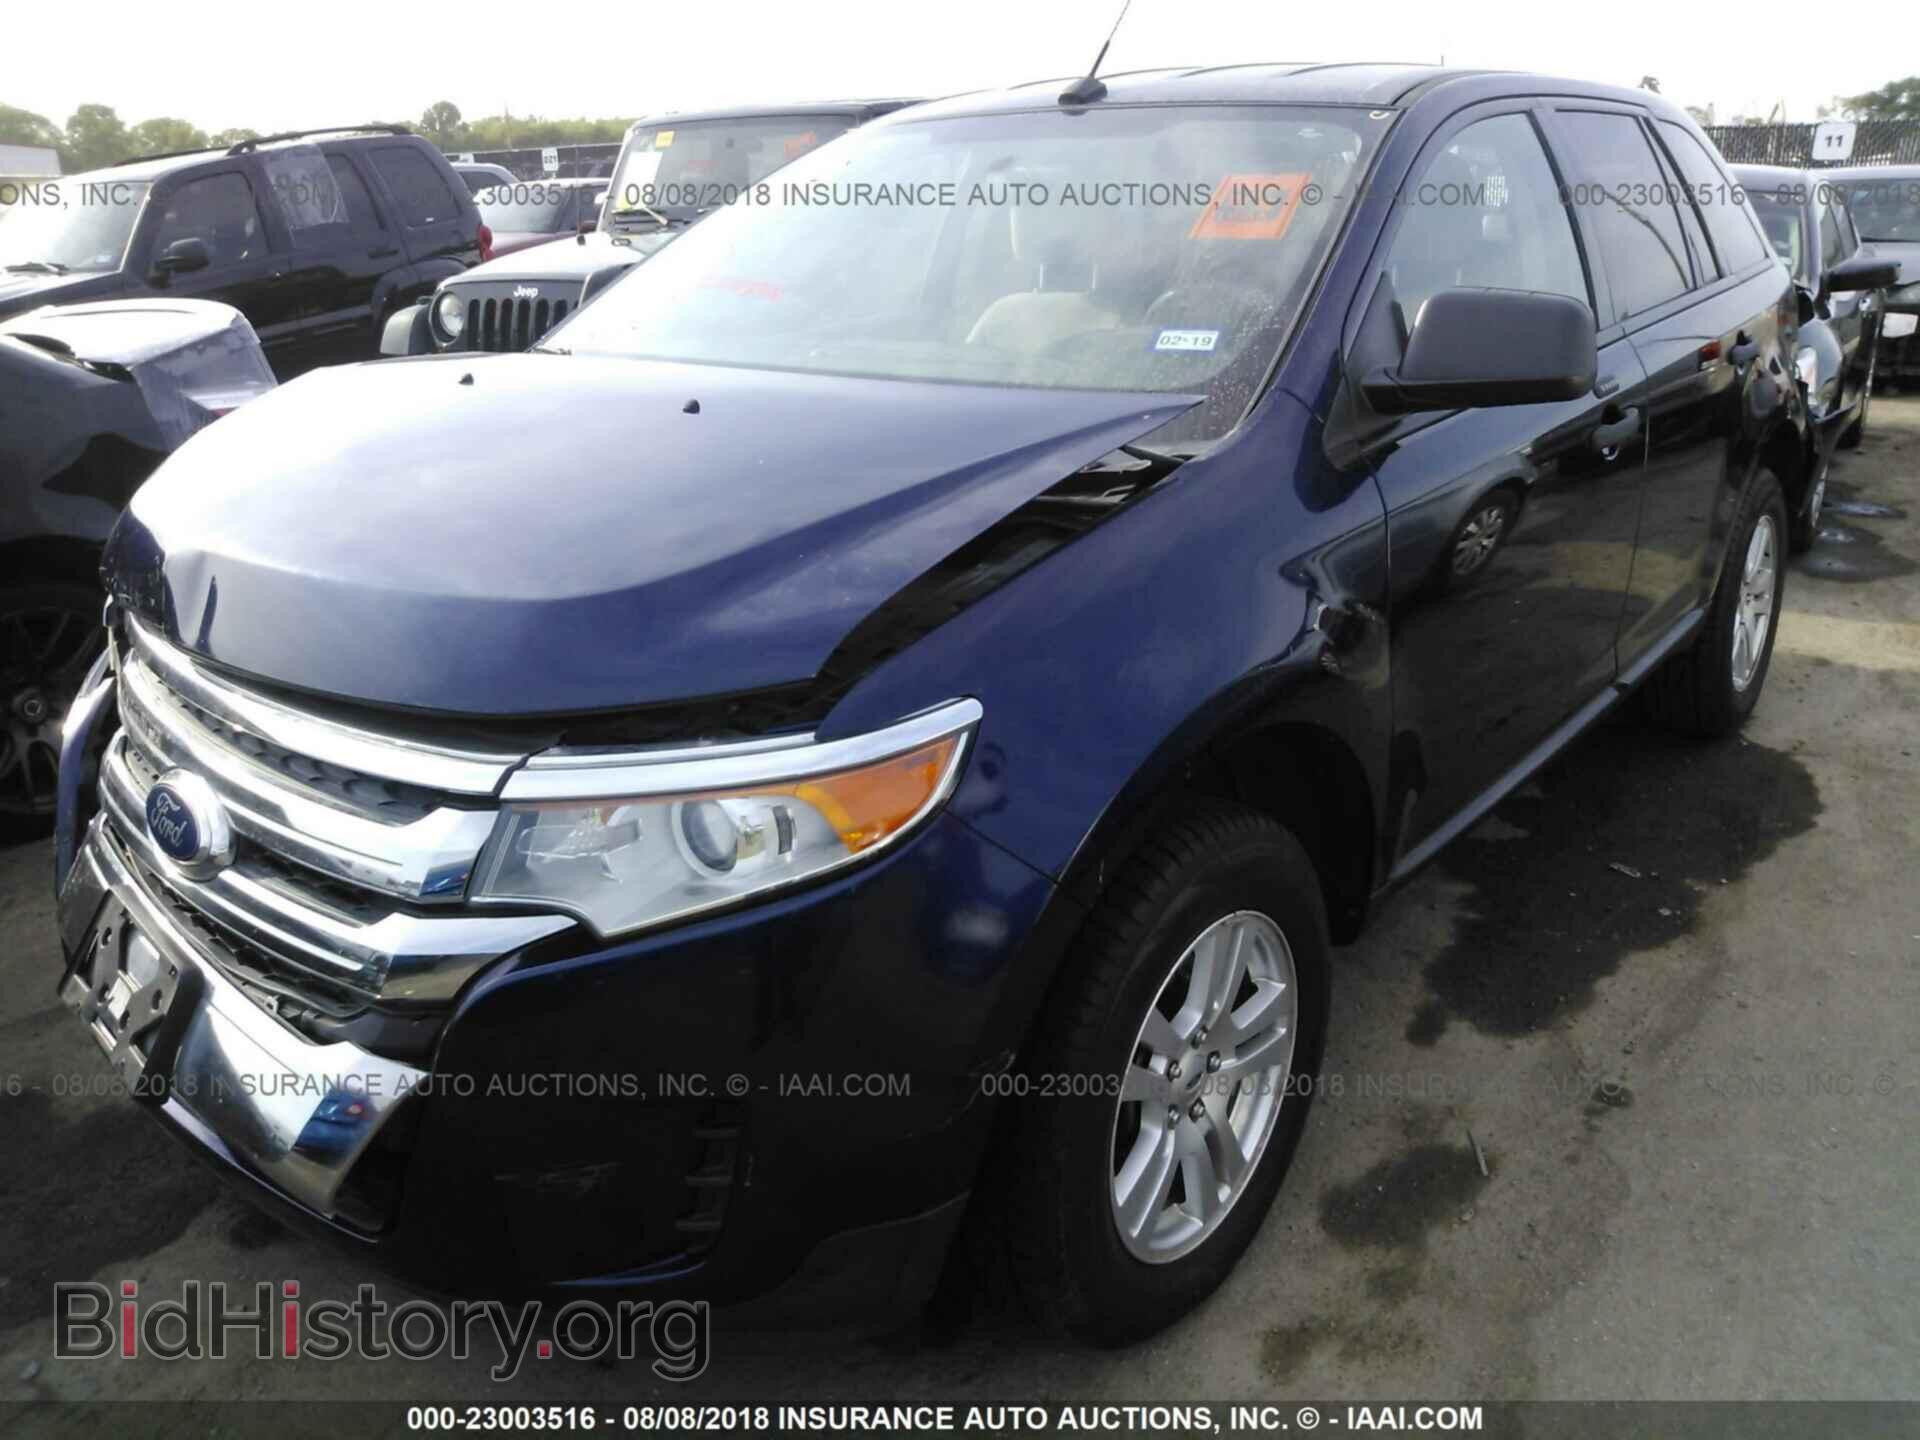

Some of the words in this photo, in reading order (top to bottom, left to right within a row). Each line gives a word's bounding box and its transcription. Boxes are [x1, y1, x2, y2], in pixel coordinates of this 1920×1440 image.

[1824, 134, 1844, 147] 11
[513, 285, 539, 297] Jeep
[150, 792, 188, 848] Ford
